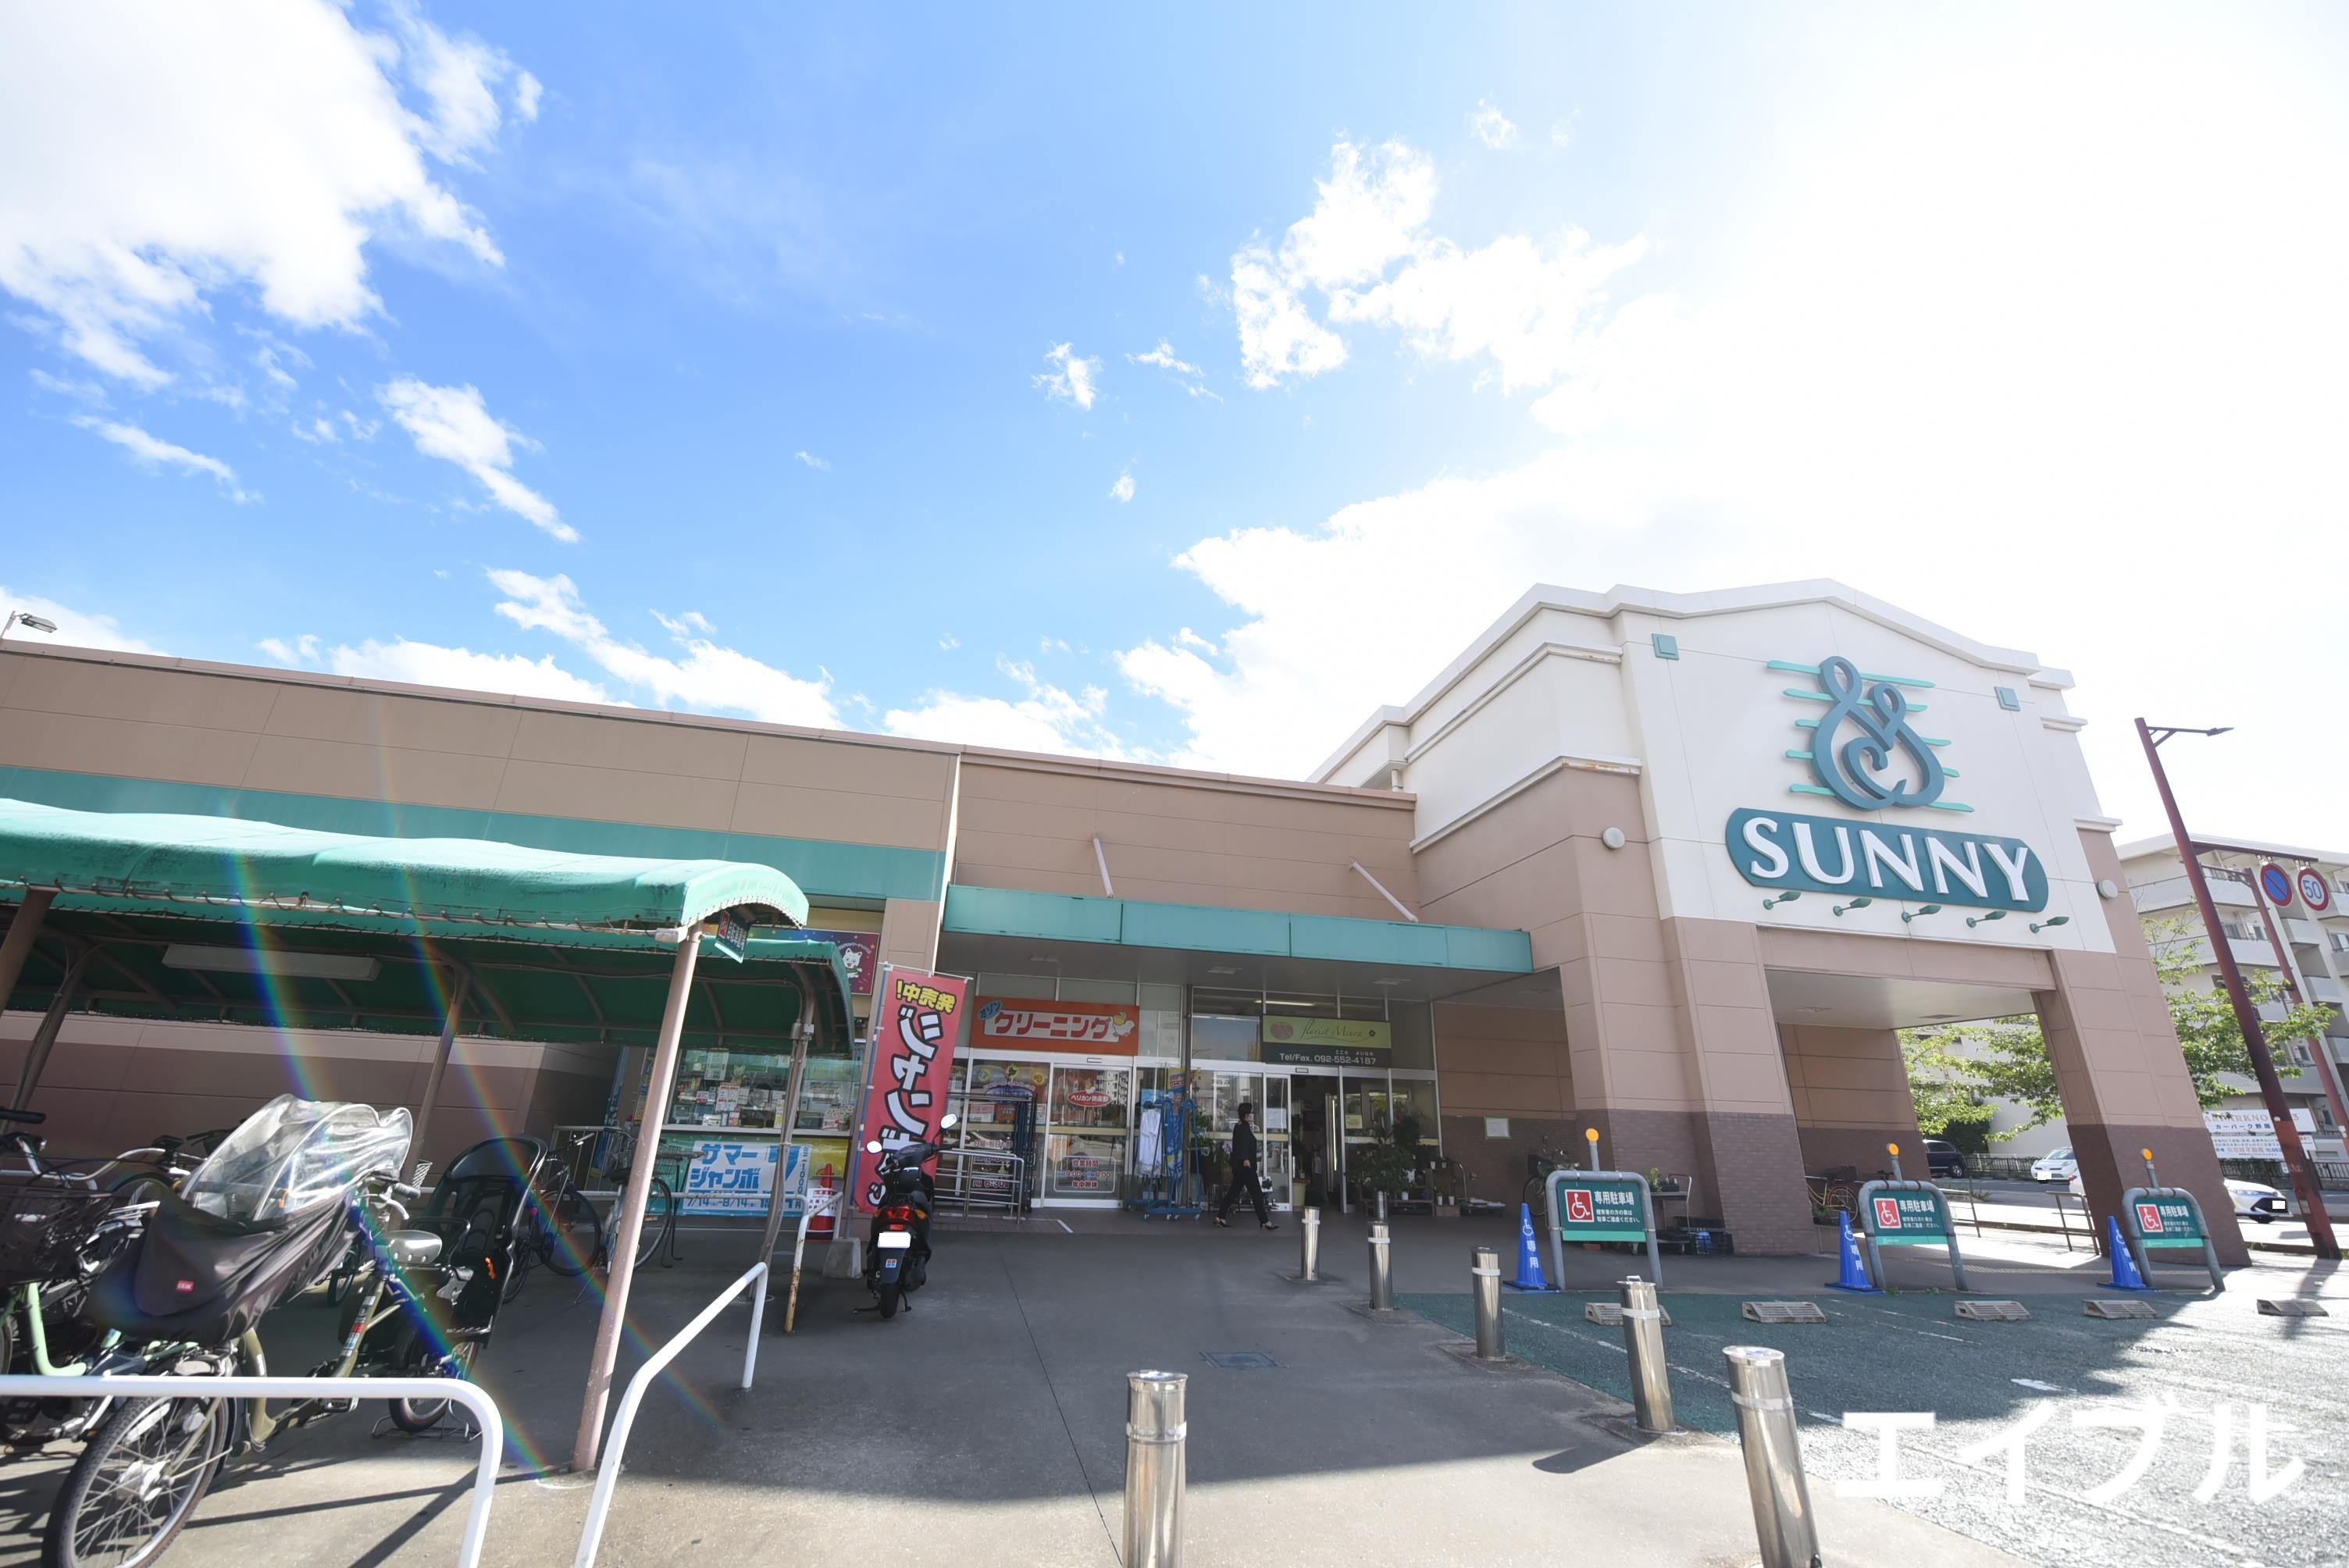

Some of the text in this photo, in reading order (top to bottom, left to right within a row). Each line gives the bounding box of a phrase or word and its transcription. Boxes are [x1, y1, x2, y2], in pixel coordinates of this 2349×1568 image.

[1742, 816, 2030, 903] SUNNY
[2302, 879, 2322, 900] 50
[979, 1002, 1002, 1020] オゾン
[994, 1011, 1112, 1039] クリーニング
[1314, 1053, 1376, 1064] 092-552-4187
[700, 1143, 759, 1165] サマー
[689, 1167, 761, 1189] ジャンボ
[1594, 1190, 1634, 1206] 専用駐車場
[1898, 1199, 1935, 1213] 専用駐車場
[1526, 1240, 1540, 1269] 専用
